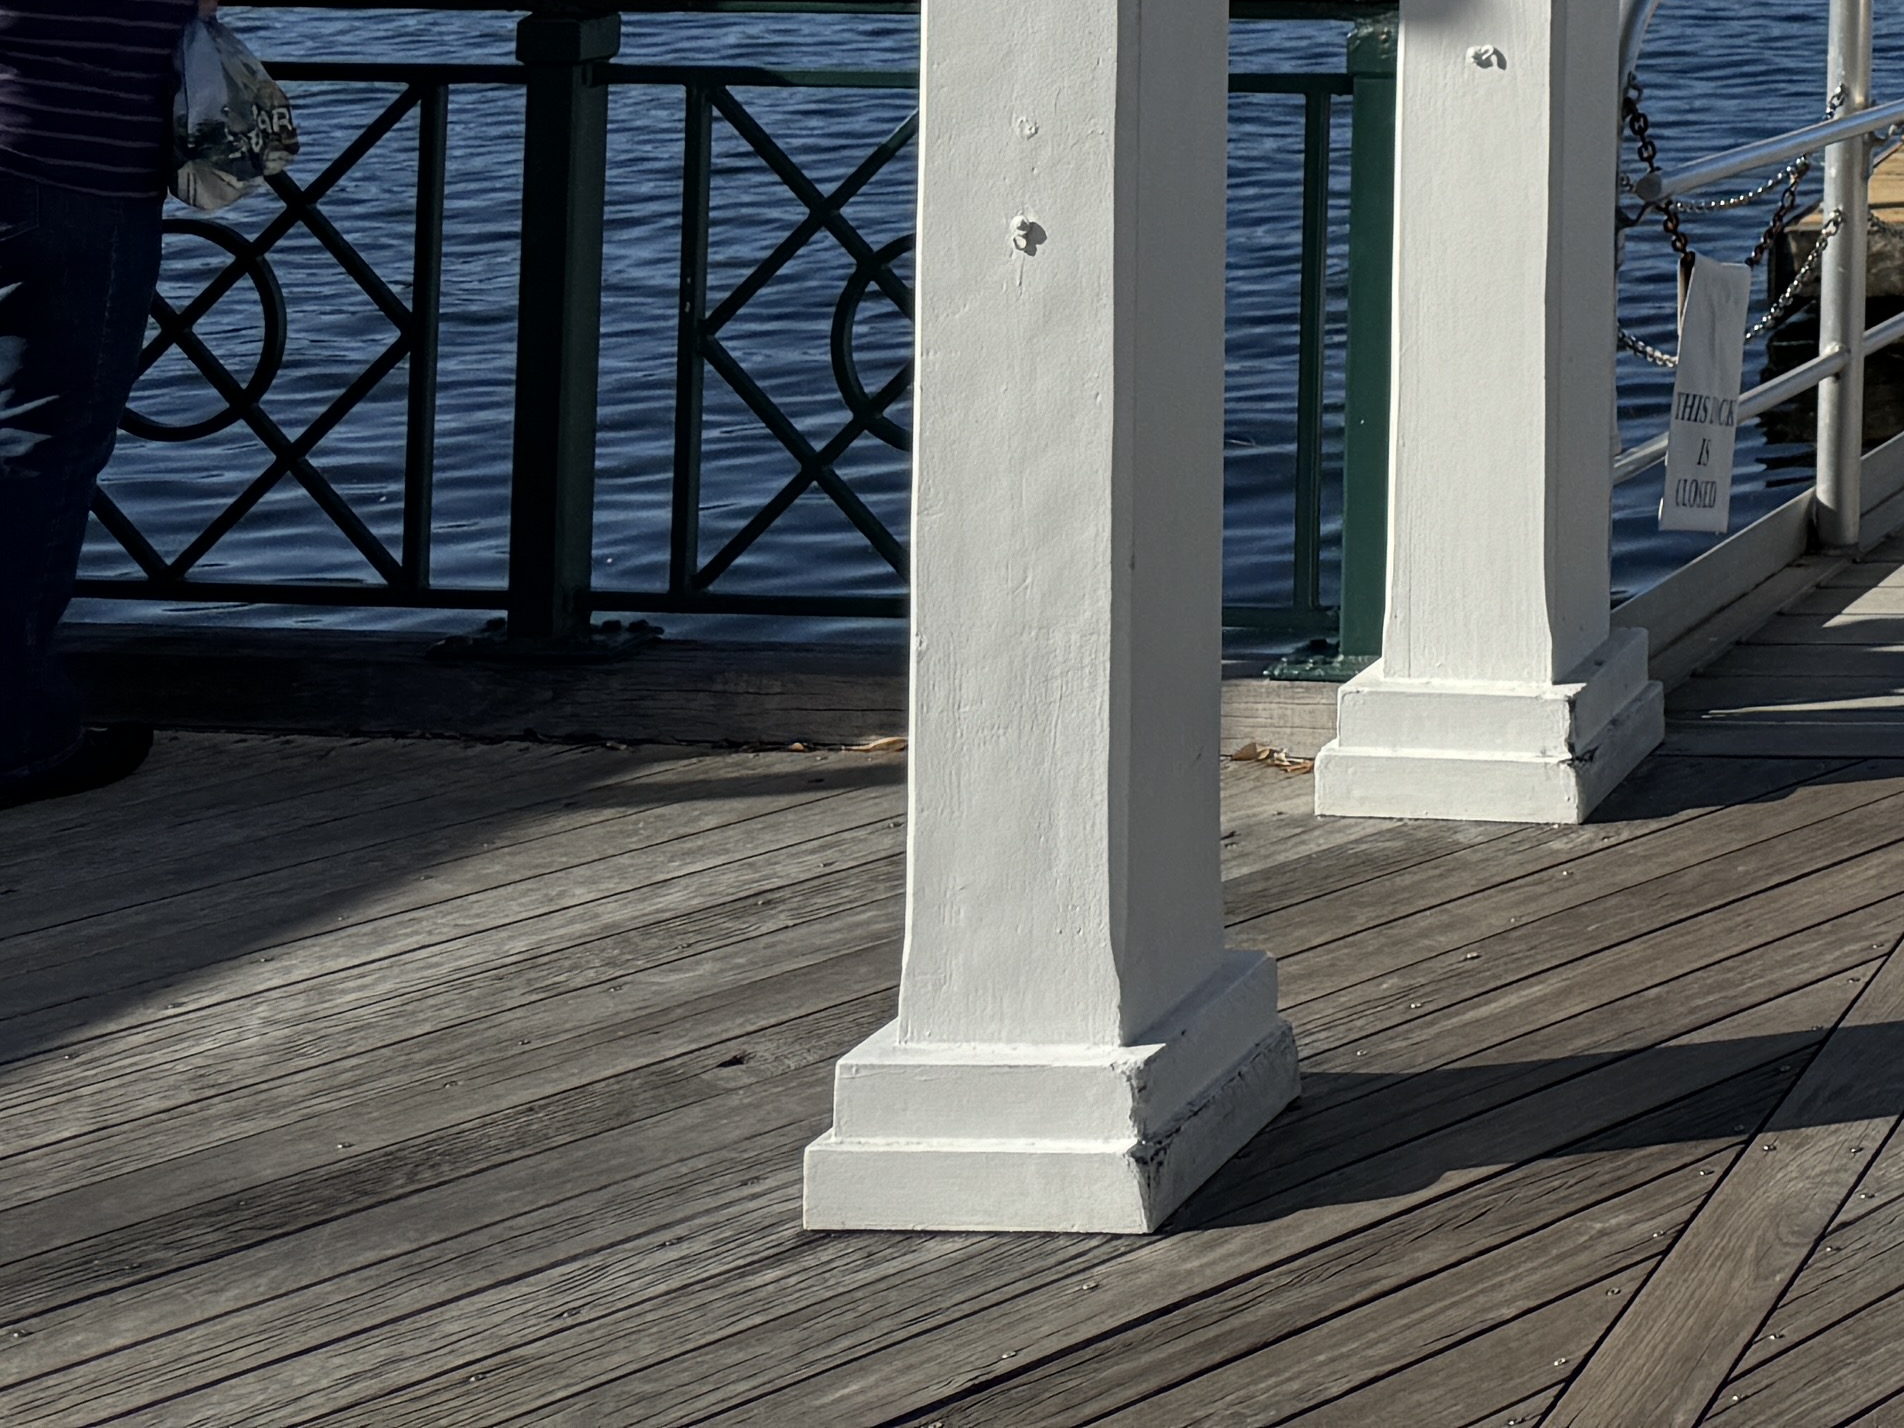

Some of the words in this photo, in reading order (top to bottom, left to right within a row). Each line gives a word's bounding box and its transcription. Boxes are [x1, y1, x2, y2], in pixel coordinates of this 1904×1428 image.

[1675, 392, 1710, 424] THIS
[1697, 437, 1711, 467] IS
[1675, 479, 1717, 508] CLOSED
